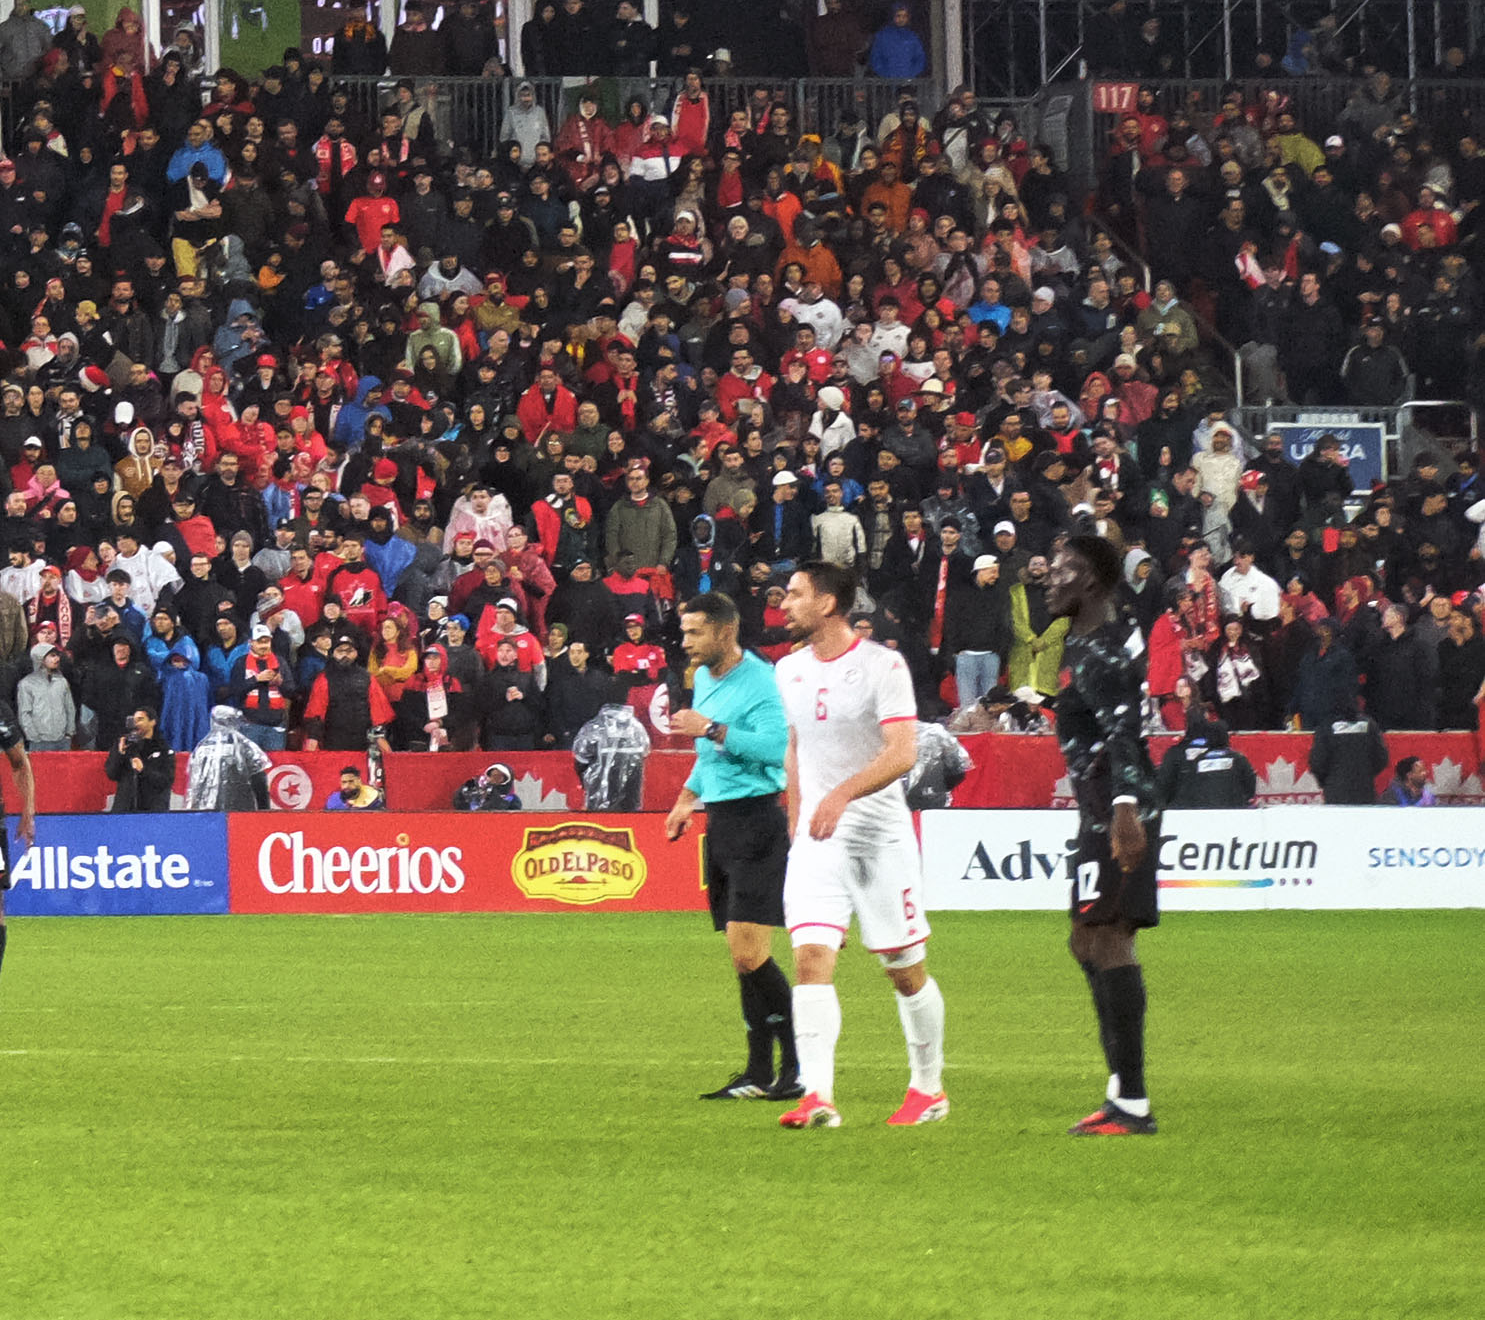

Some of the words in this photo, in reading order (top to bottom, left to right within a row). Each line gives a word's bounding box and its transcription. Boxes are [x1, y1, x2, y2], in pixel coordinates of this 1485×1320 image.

[1099, 85, 1133, 110] 117
[815, 687, 829, 721] 6
[10, 845, 191, 891] Allstate
[258, 831, 466, 895] Cheerios
[524, 856, 560, 881] OLD
[961, 838, 1080, 881] Advi
[1158, 836, 1319, 872] Centrum
[901, 887, 917, 921] 6
